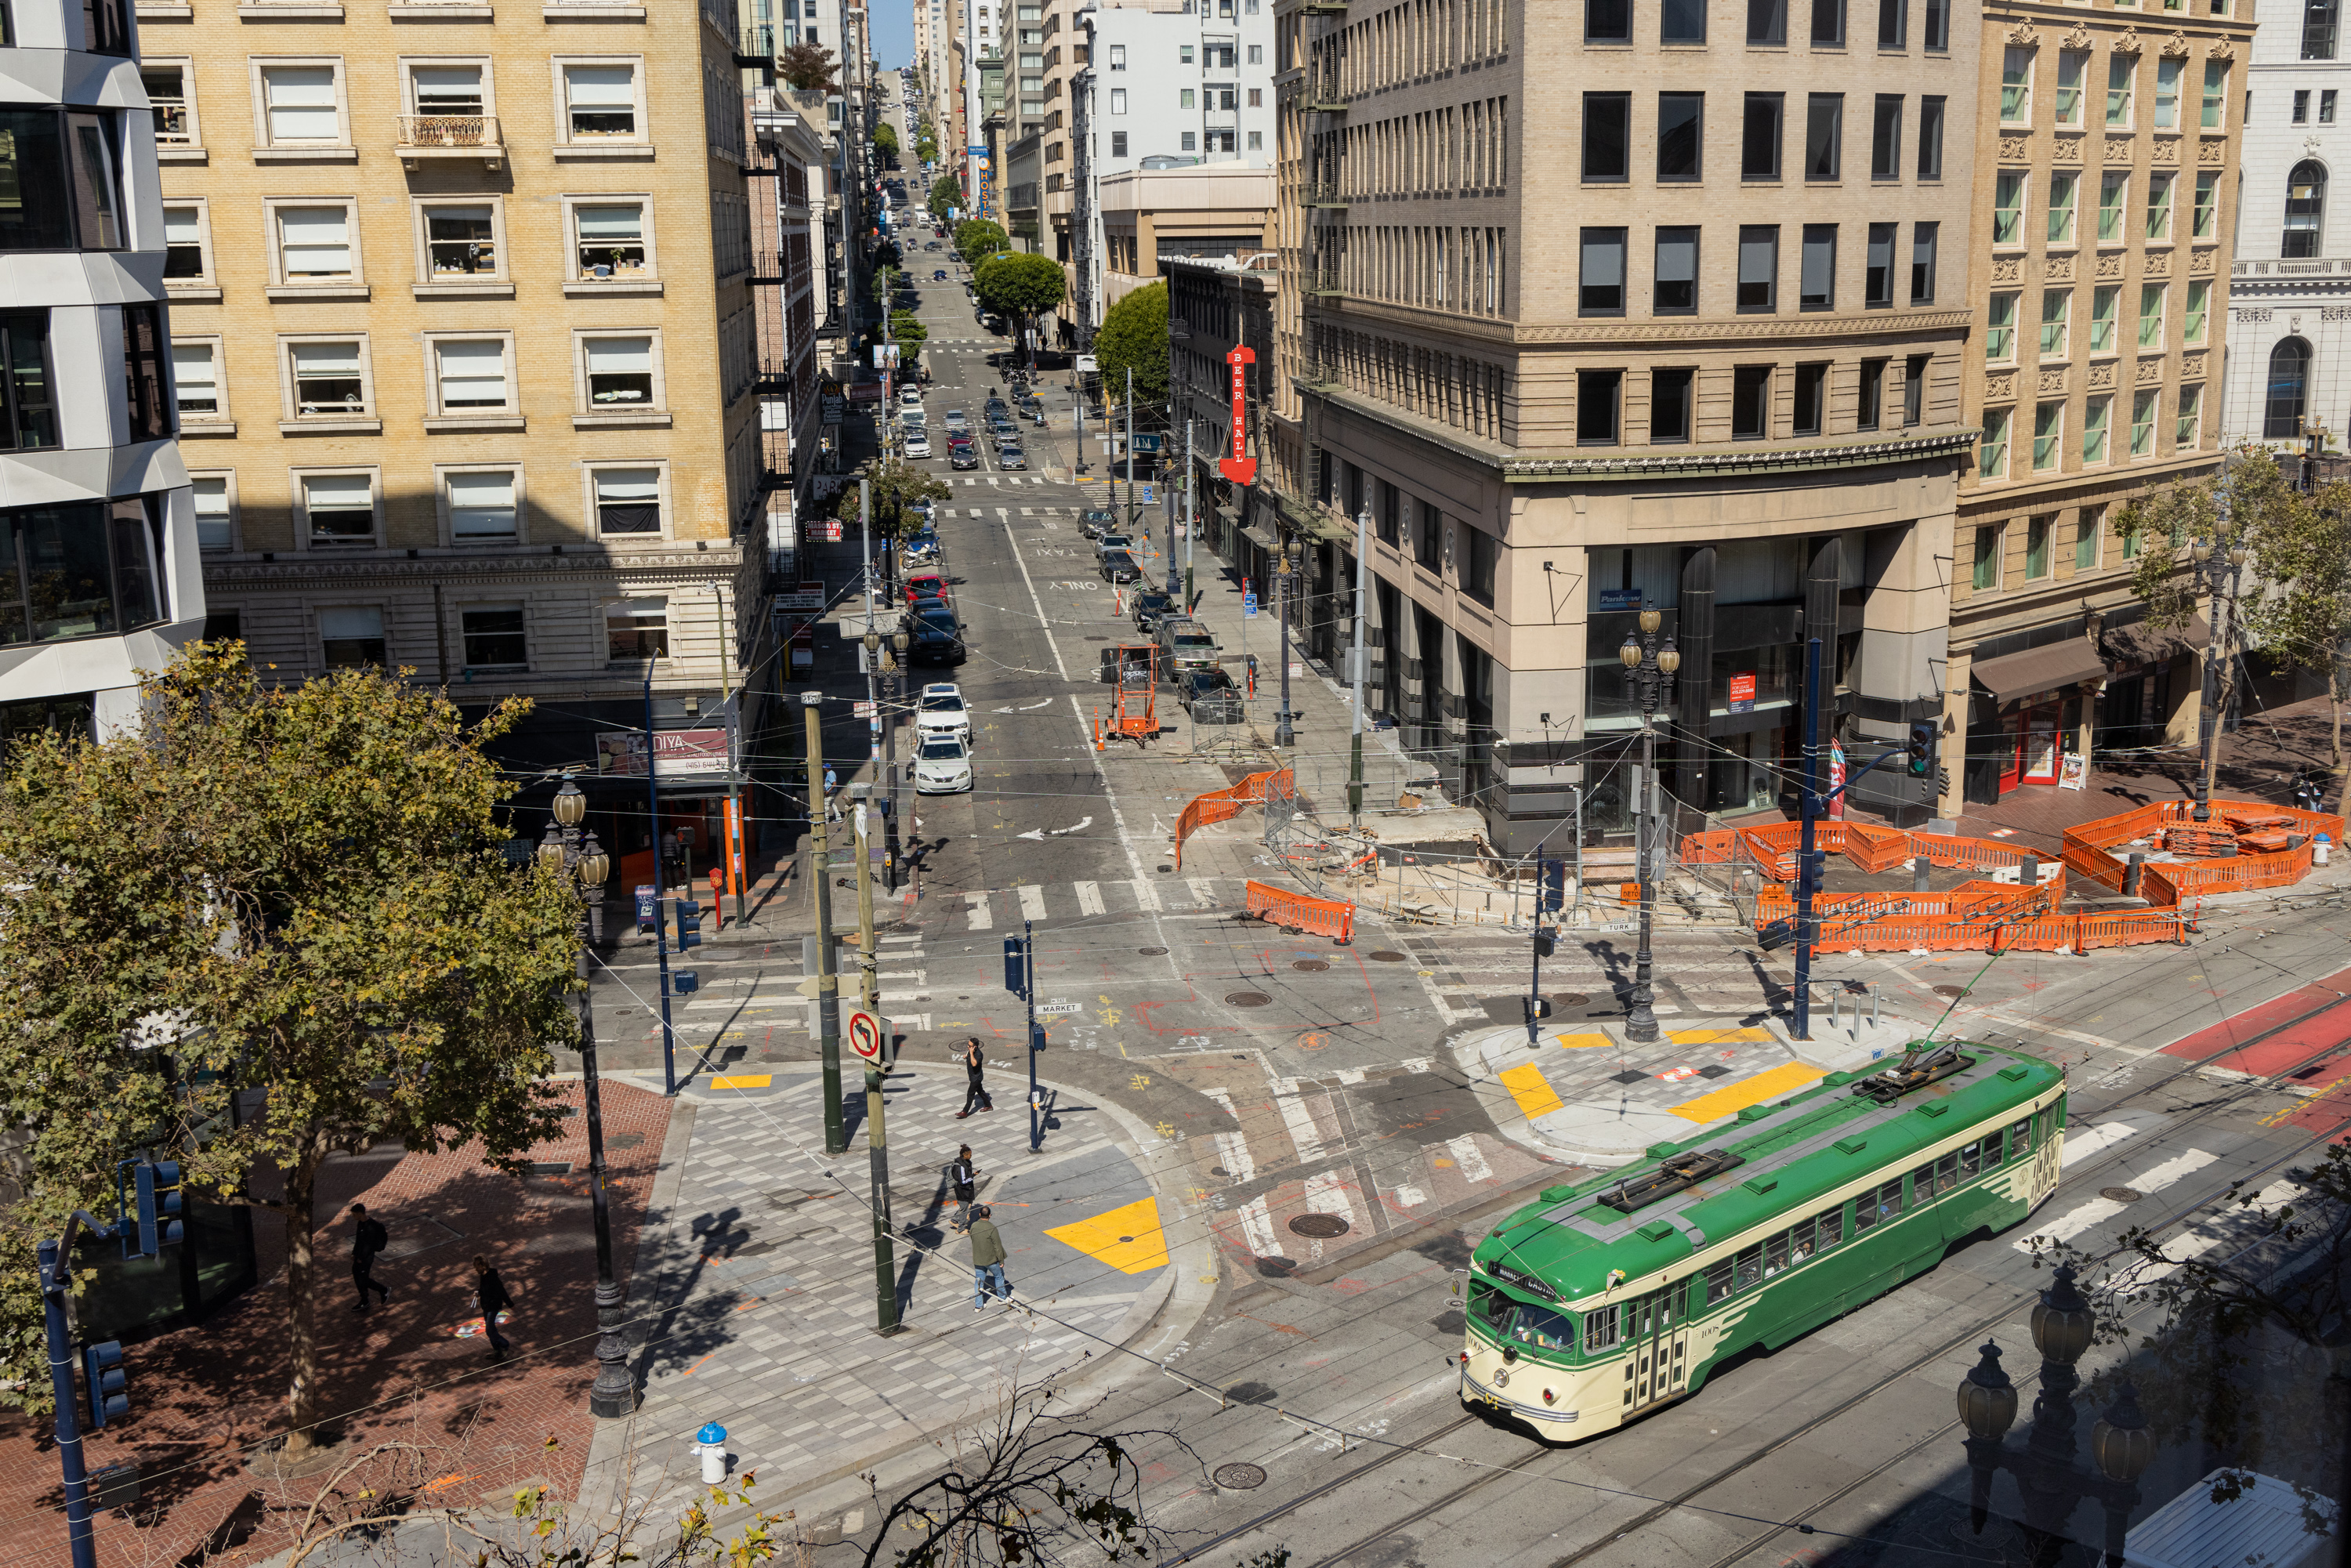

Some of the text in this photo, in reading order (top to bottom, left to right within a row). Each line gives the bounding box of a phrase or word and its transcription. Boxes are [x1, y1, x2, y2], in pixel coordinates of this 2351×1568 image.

[866, 148, 875, 212] PARKING
[828, 227, 839, 324] HOTEL
[822, 392, 843, 407] Punjab
[1050, 581, 1097, 590] ONLY
[653, 735, 684, 751] DIYA
[1499, 1265, 1520, 1282] MARKET
[1528, 1278, 1555, 1296] CASTRO
[1702, 1324, 1719, 1338] 1008
